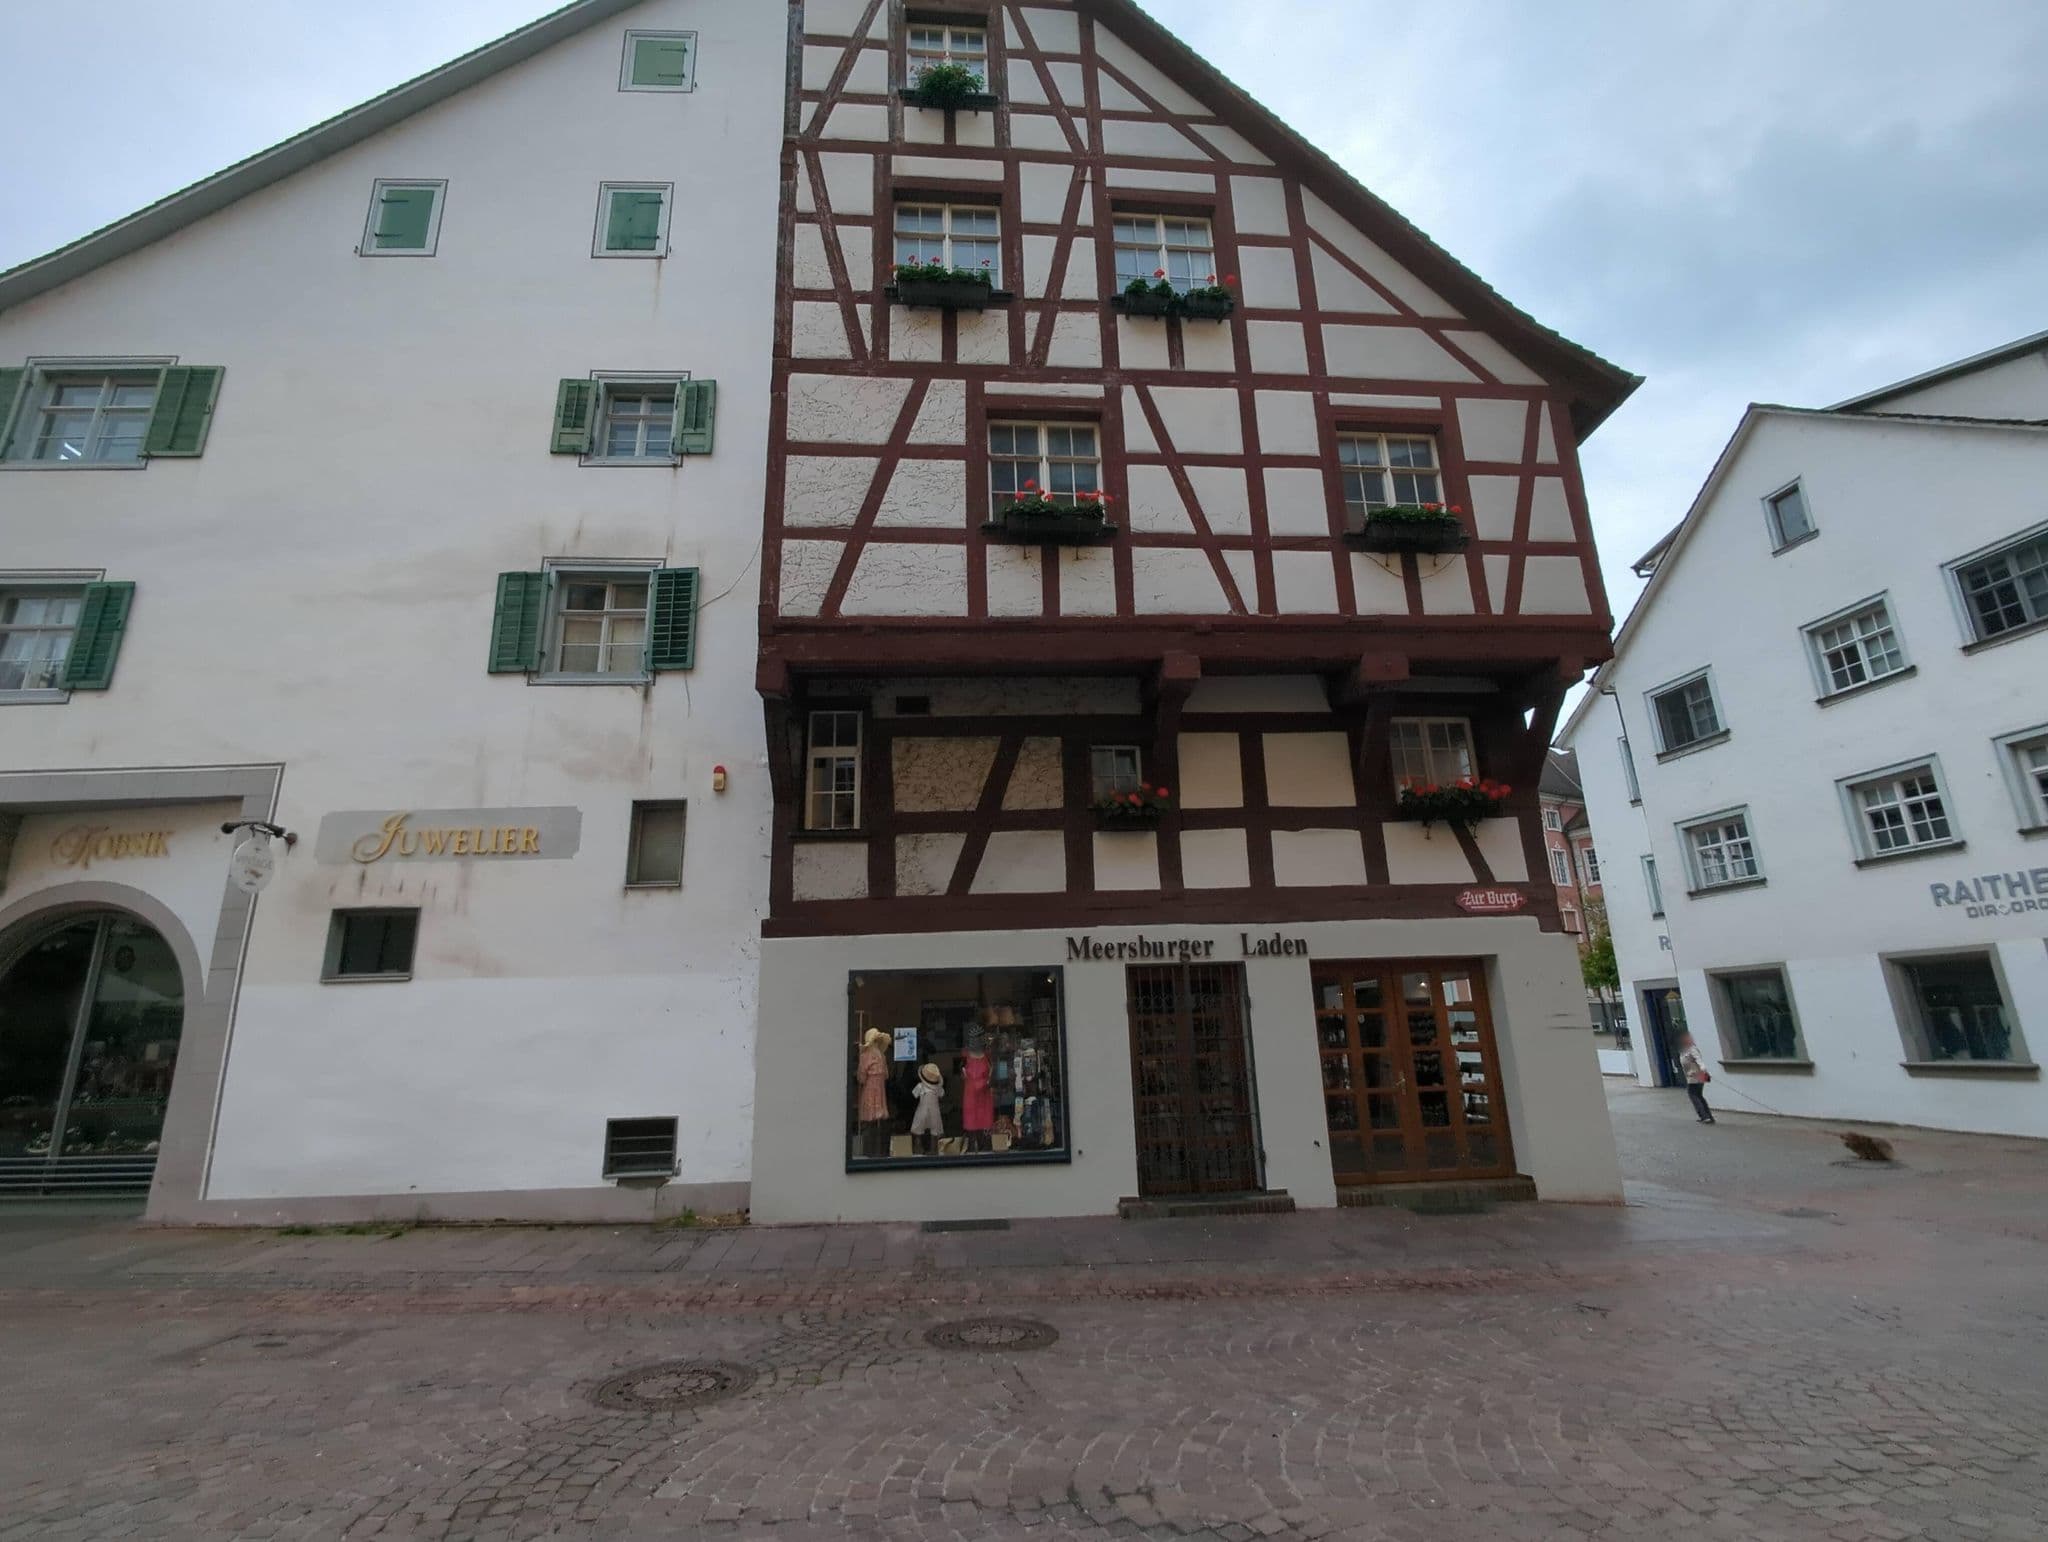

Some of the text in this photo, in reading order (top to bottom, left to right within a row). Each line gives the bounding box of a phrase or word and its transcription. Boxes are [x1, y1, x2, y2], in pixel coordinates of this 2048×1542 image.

[351, 811, 541, 865] JUWELIER
[1461, 891, 1523, 907] Zur Burg
[1929, 867, 2048, 908] RAITHE
[1065, 932, 1309, 963] Meersburger Laden
